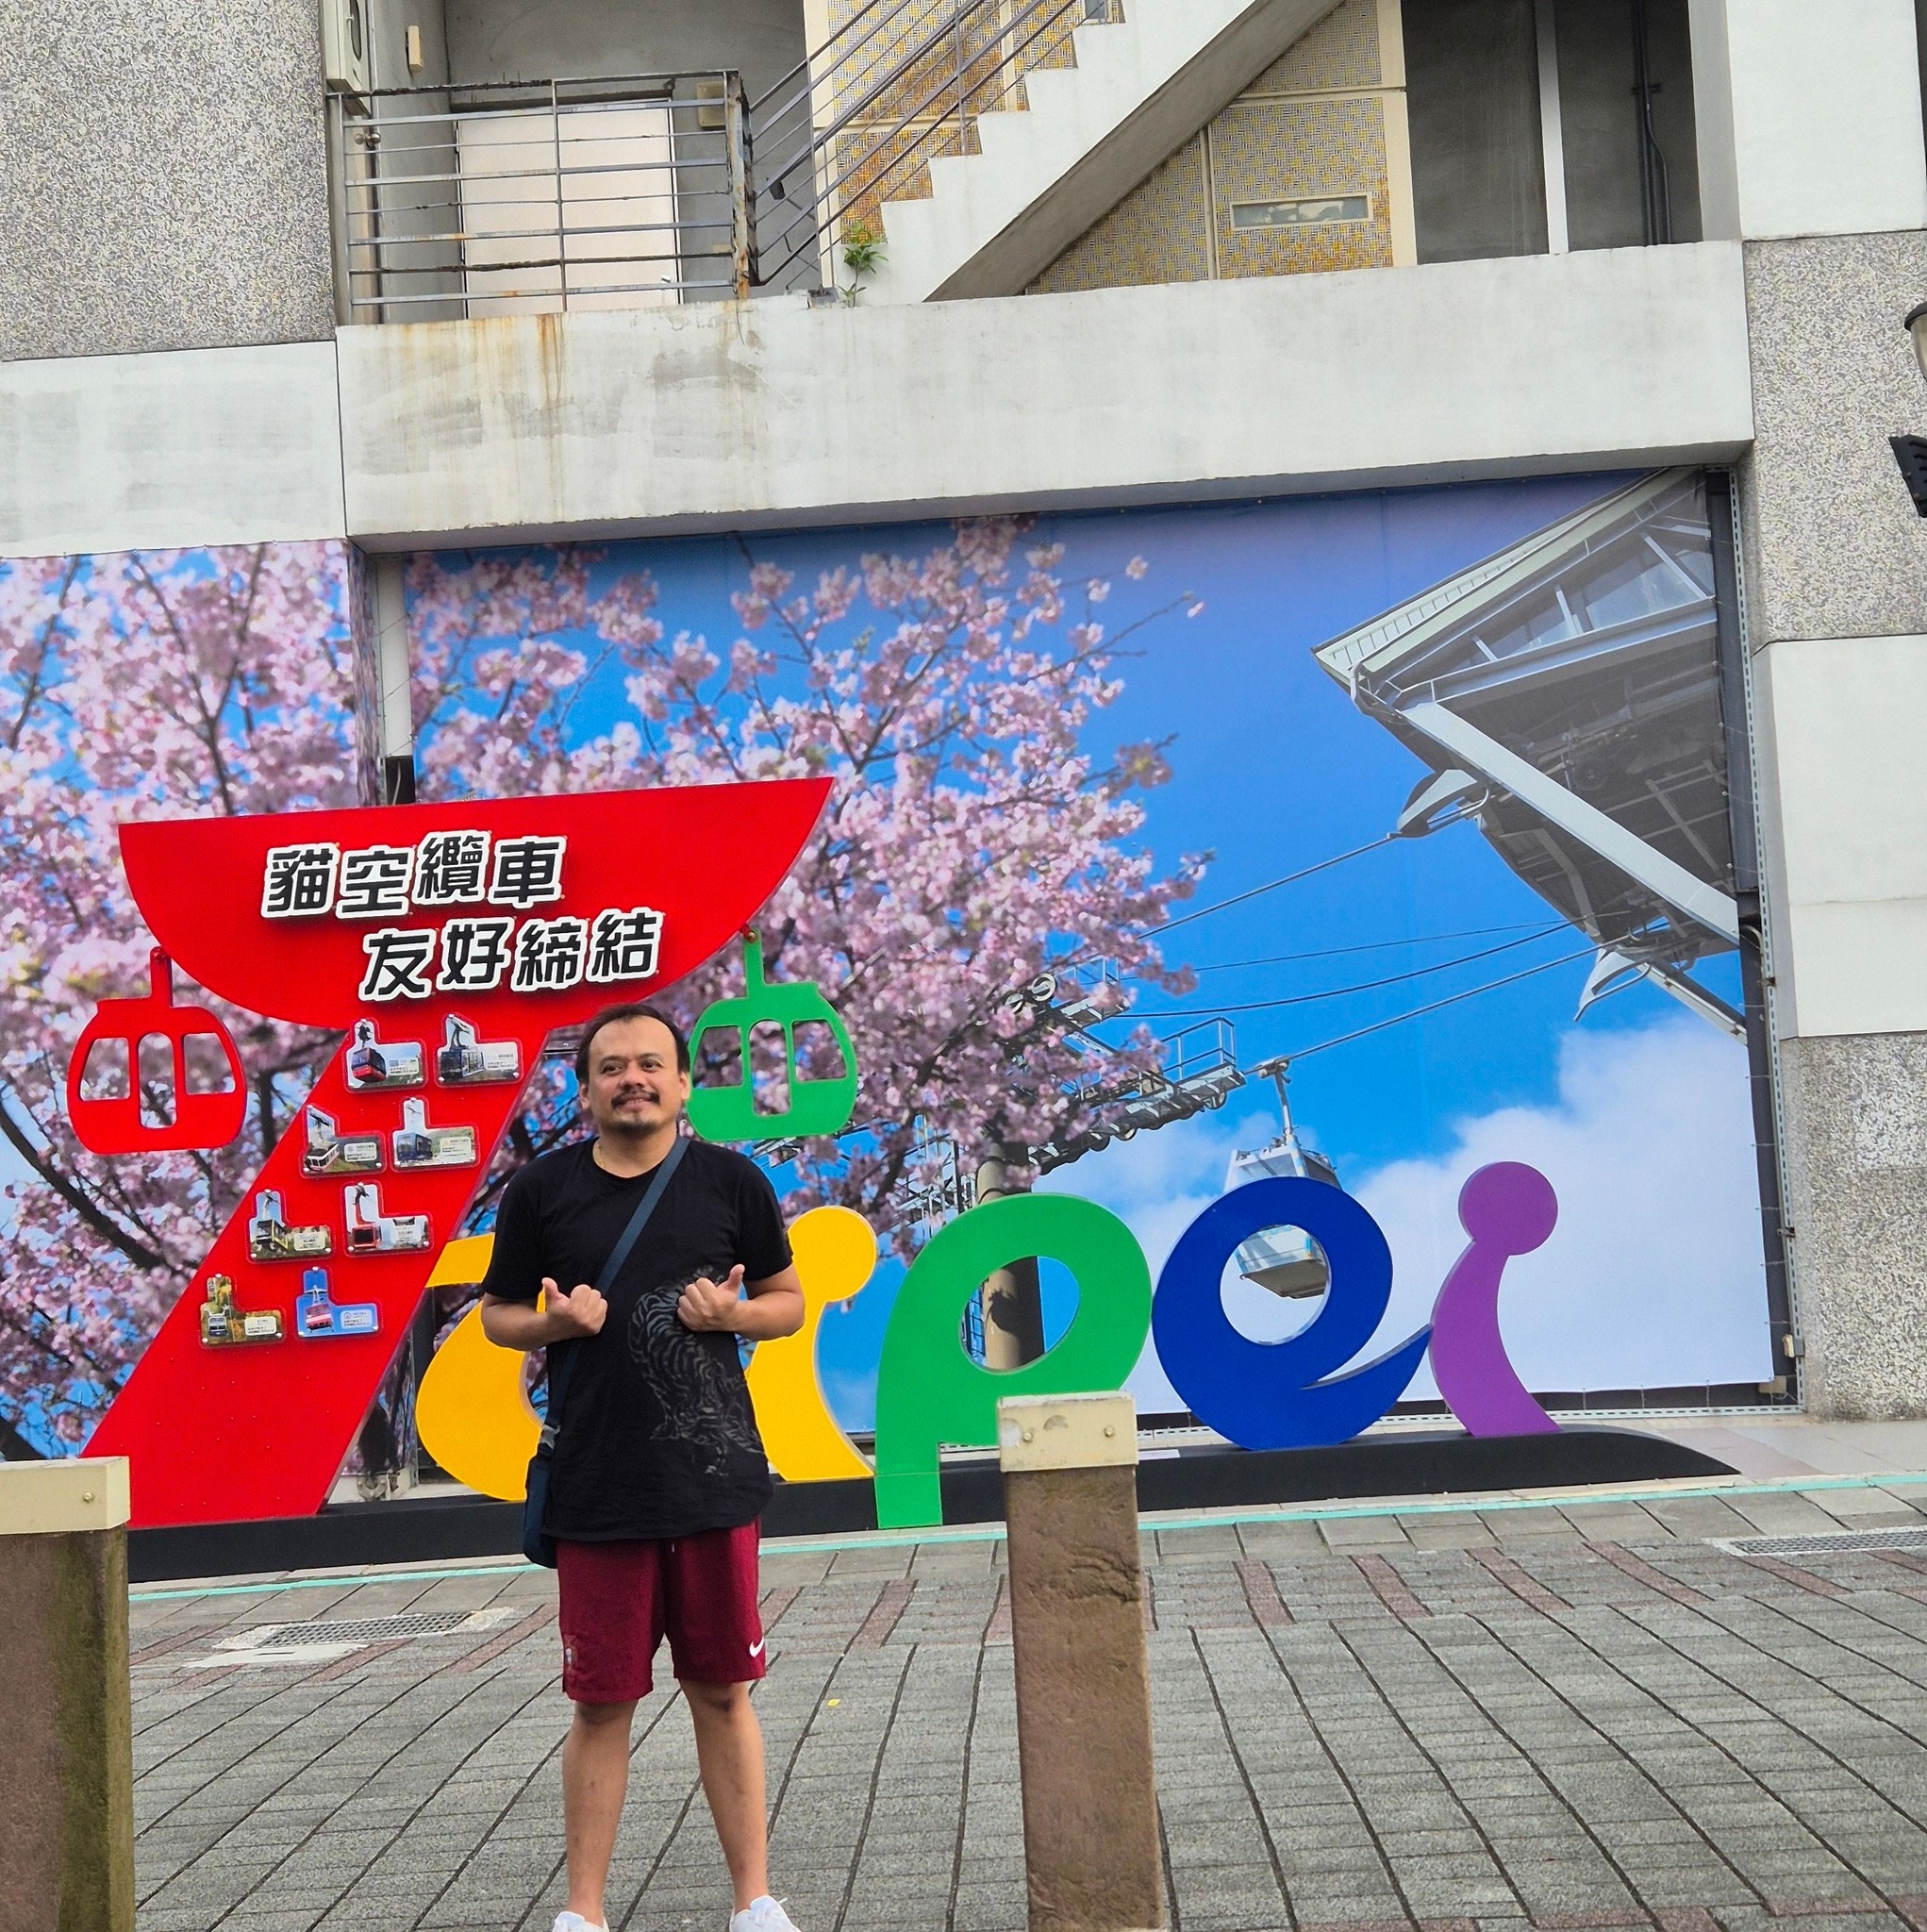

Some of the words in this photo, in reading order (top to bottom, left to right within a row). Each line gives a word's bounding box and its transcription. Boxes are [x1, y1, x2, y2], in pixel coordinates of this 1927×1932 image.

[262, 831, 567, 919] 貓空纜車
[358, 908, 665, 1001] 友好締結
